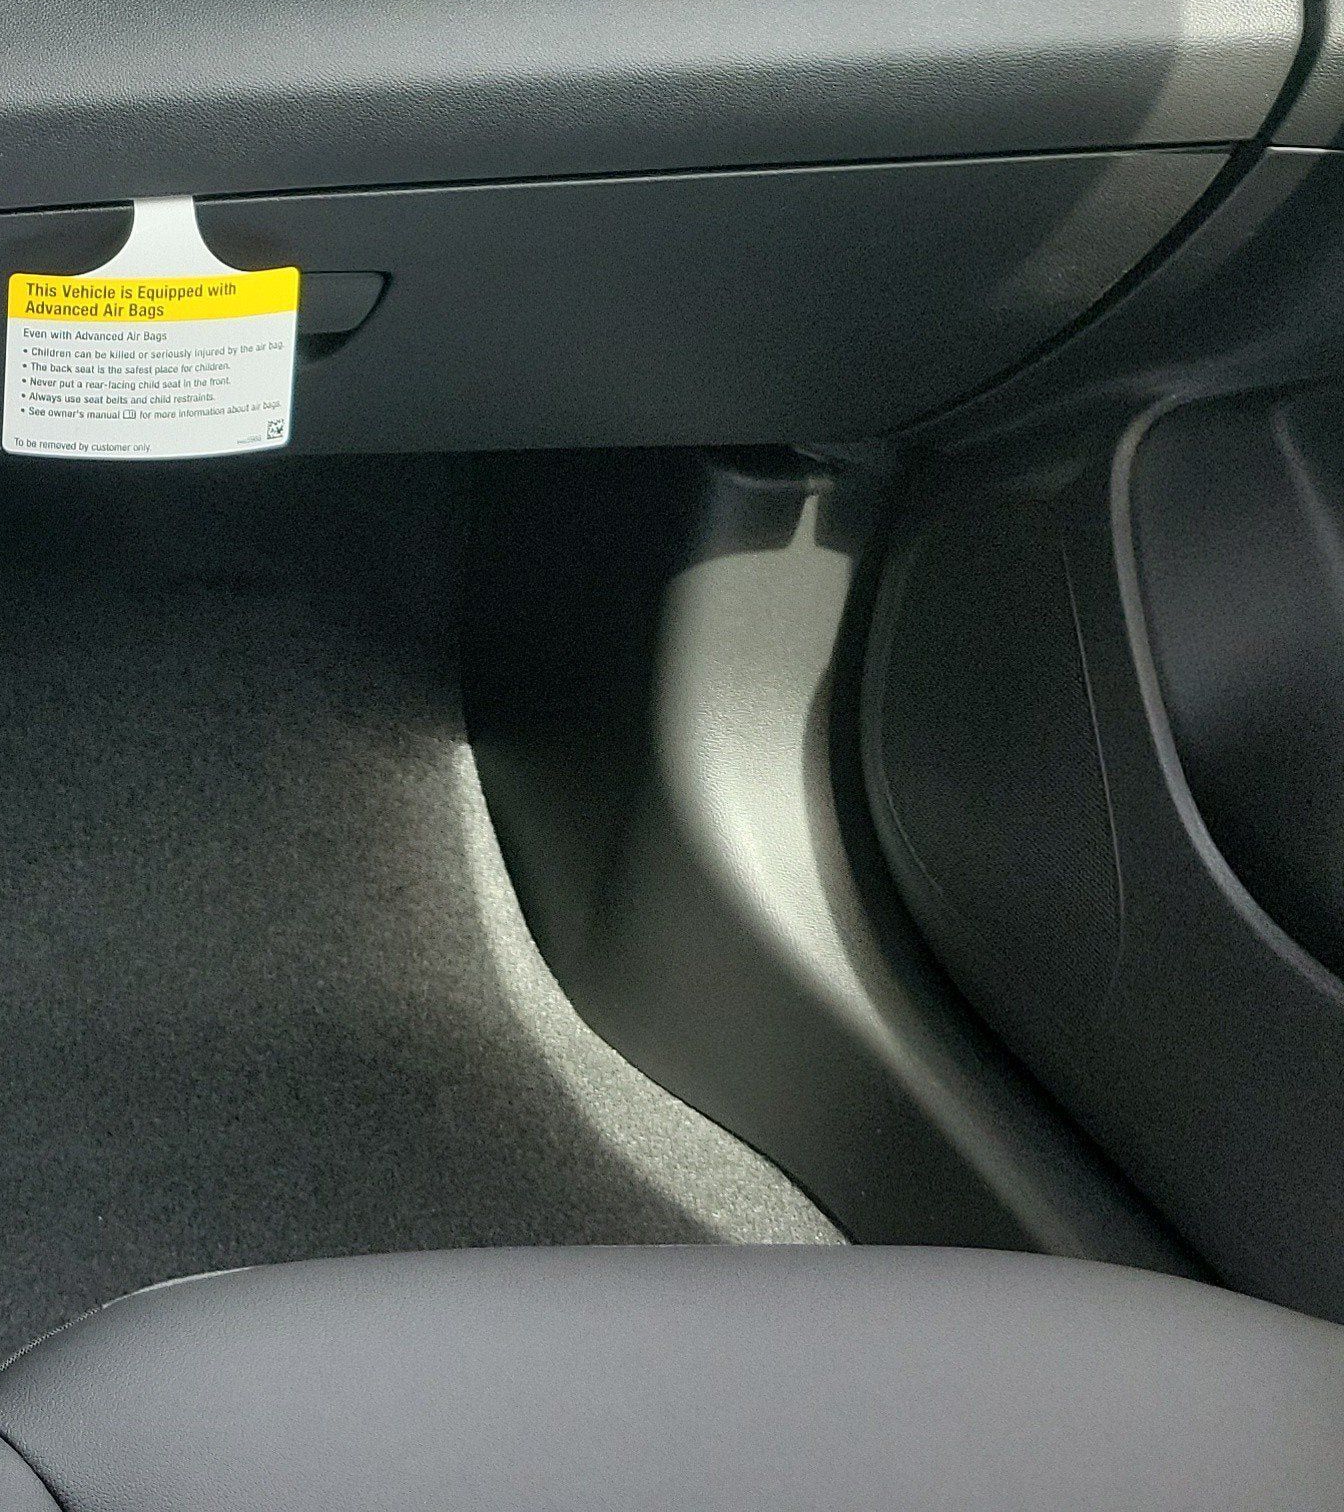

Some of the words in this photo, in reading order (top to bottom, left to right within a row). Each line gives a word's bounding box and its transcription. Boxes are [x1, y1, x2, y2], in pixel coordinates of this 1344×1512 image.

[26, 283, 57, 297] This
[63, 285, 115, 299] Vehicle
[121, 286, 132, 299] is
[138, 284, 203, 301] Equipped
[208, 282, 236, 296] with
[25, 300, 98, 316] Advanced
[103, 303, 124, 316] Air
[129, 304, 164, 319] Bags
[23, 328, 47, 338] Even
[50, 330, 72, 340] with
[75, 331, 123, 341] Advanced
[127, 331, 140, 341] Air
[144, 332, 167, 343] Bags
[31, 347, 71, 358] Children
[74, 350, 91, 358] can
[95, 348, 106, 359] be
[109, 349, 135, 359] killed
[151, 349, 191, 359] seriously
[194, 346, 225, 358] injured
[228, 345, 238, 355] by
[240, 343, 253, 353] the
[255, 342, 266, 352] air
[31, 362, 47, 371] The
[50, 363, 72, 373] back
[75, 364, 94, 374] seat
[97, 365, 105, 374] is
[108, 365, 122, 374] the
[124, 365, 152, 374] safest
[154, 365, 178, 375] place
[181, 364, 192, 373] for
[195, 362, 230, 372] children.
[30, 377, 57, 387] Never
[59, 379, 74, 389] put
[86, 380, 136, 391] rear-facing
[138, 380, 160, 389] child
[162, 380, 180, 389] seat
[183, 379, 191, 388] in
[194, 378, 207, 387] the
[29, 392, 61, 403] Always
[83, 394, 103, 404] seat
[106, 394, 127, 404] belts
[130, 394, 147, 404] and
[150, 394, 171, 404] child
[29, 407, 46, 416] See
[47, 409, 84, 418] owner's
[87, 409, 120, 419] manual
[140, 410, 151, 419] for
[178, 408, 224, 418] information
[227, 404, 249, 414] about
[251, 402, 260, 412] air
[14, 438, 23, 447] To
[26, 438, 37, 448] be
[39, 440, 76, 451] removed
[79, 441, 88, 452] by
[91, 443, 131, 452] customer
[133, 443, 152, 452] only.
